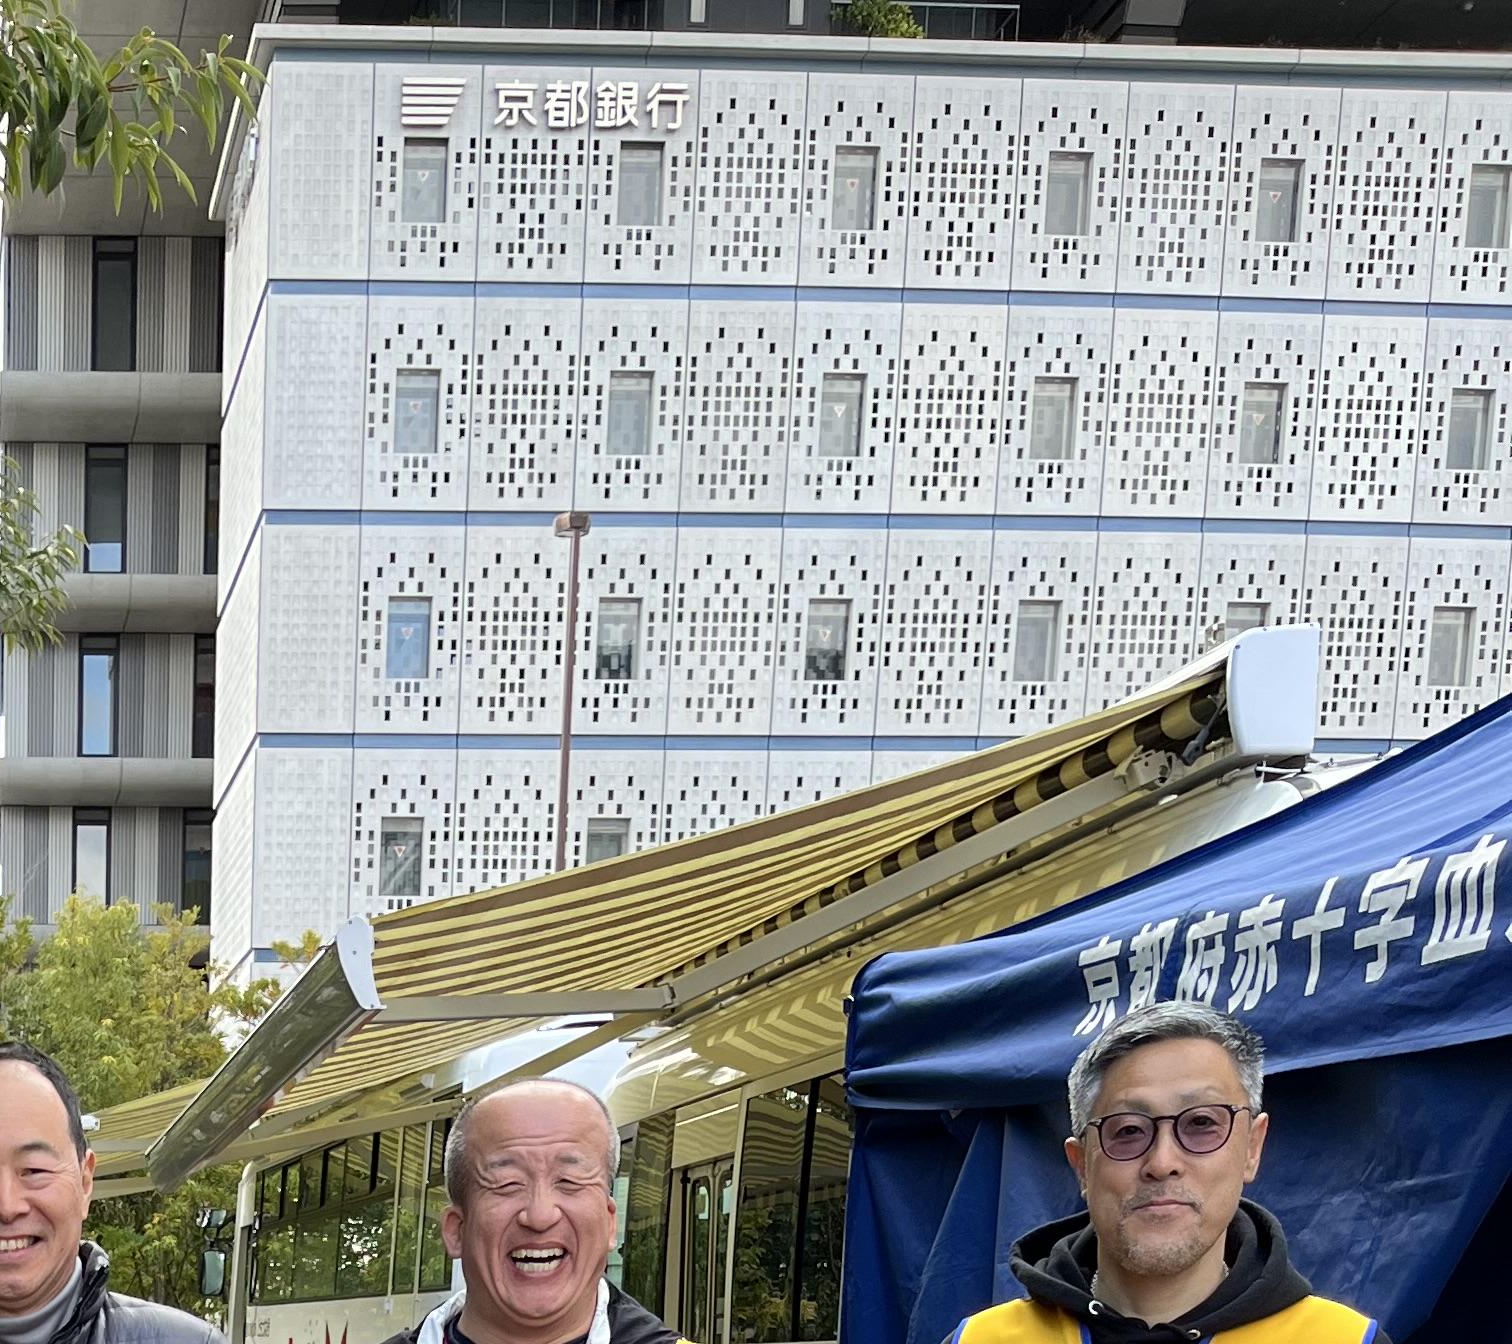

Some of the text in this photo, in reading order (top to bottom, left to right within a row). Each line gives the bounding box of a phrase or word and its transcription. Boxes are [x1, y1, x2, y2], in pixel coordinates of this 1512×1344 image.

[494, 79, 690, 129] 京都銀行
[1072, 833, 1512, 1037] 京都府赤十字血
